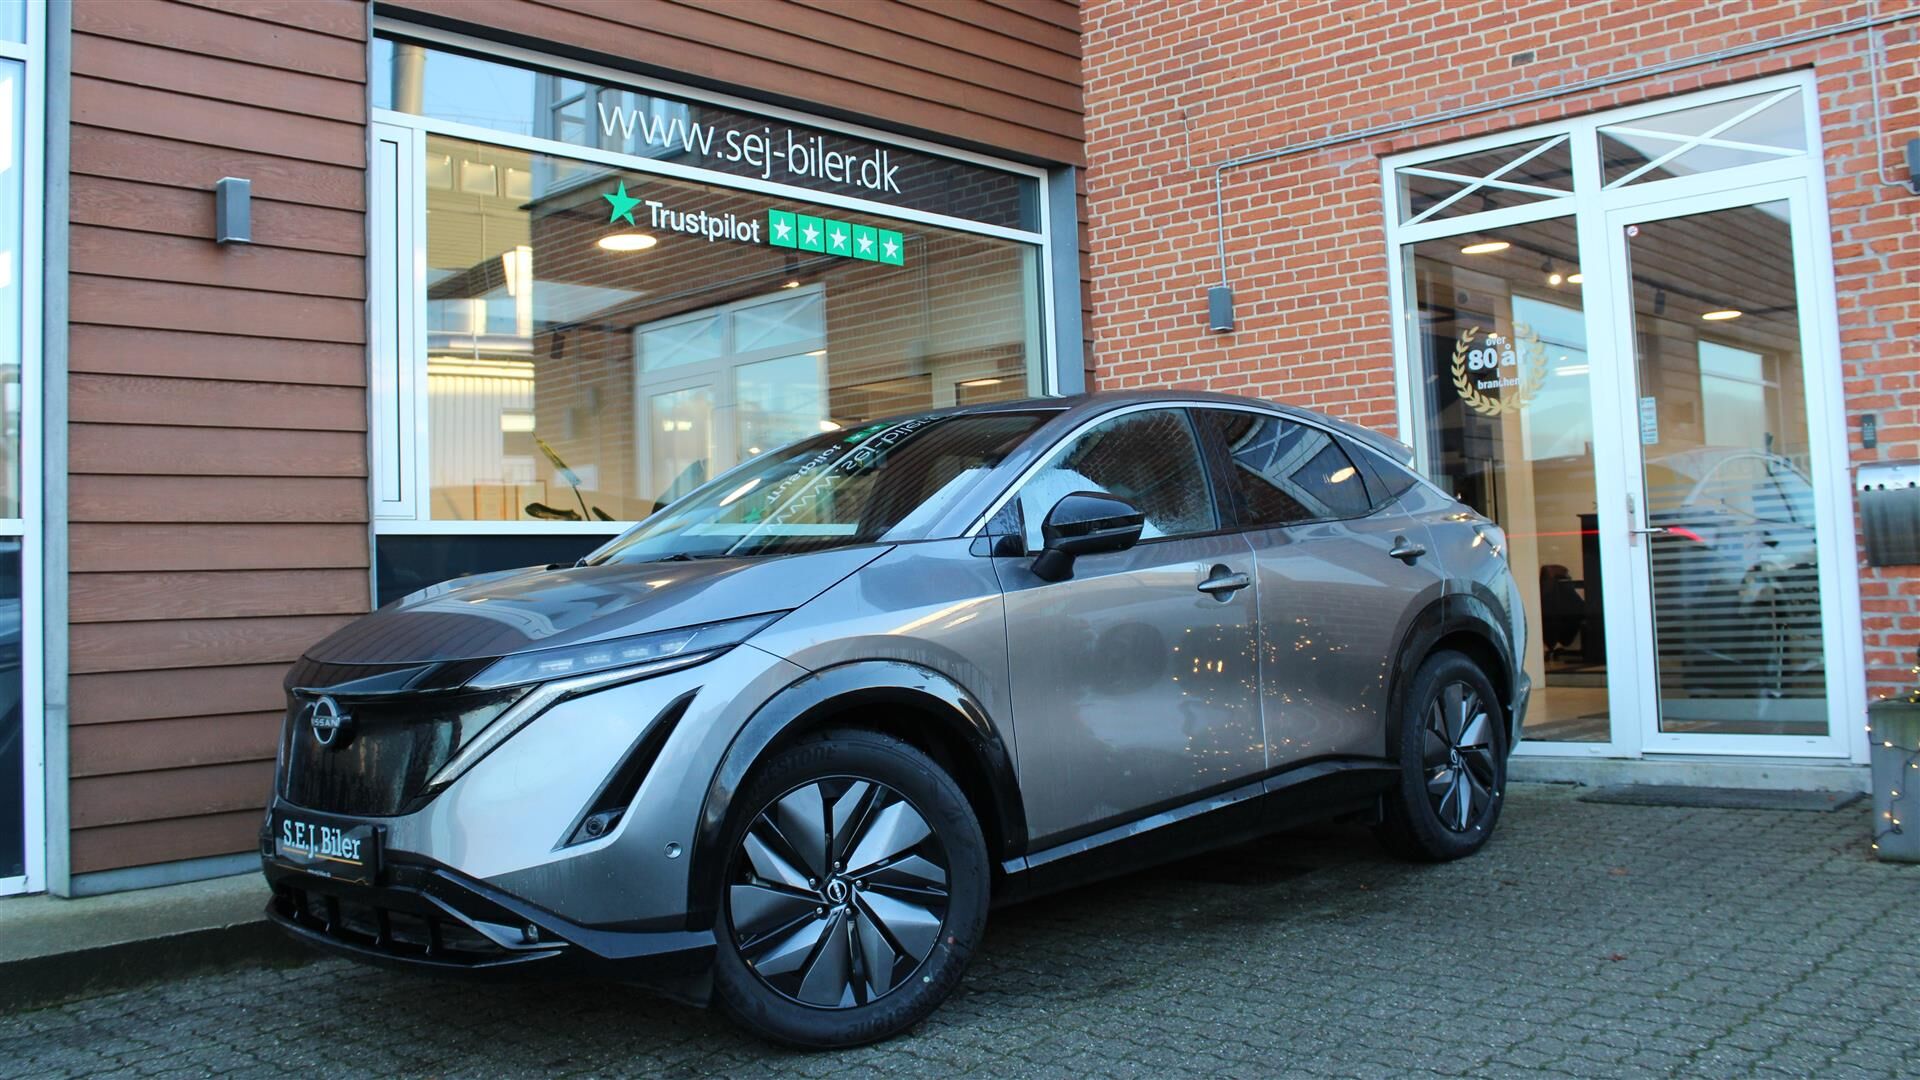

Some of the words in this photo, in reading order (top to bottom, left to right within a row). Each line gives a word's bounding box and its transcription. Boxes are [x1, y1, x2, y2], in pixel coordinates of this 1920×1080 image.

[597, 102, 901, 194] www.sej-biler.dk
[645, 200, 760, 244] Trustpilot
[1468, 348, 1498, 371] 80
[1477, 377, 1520, 390] branchen
[283, 819, 318, 860] S.E.J.
[321, 827, 360, 860] Biler
